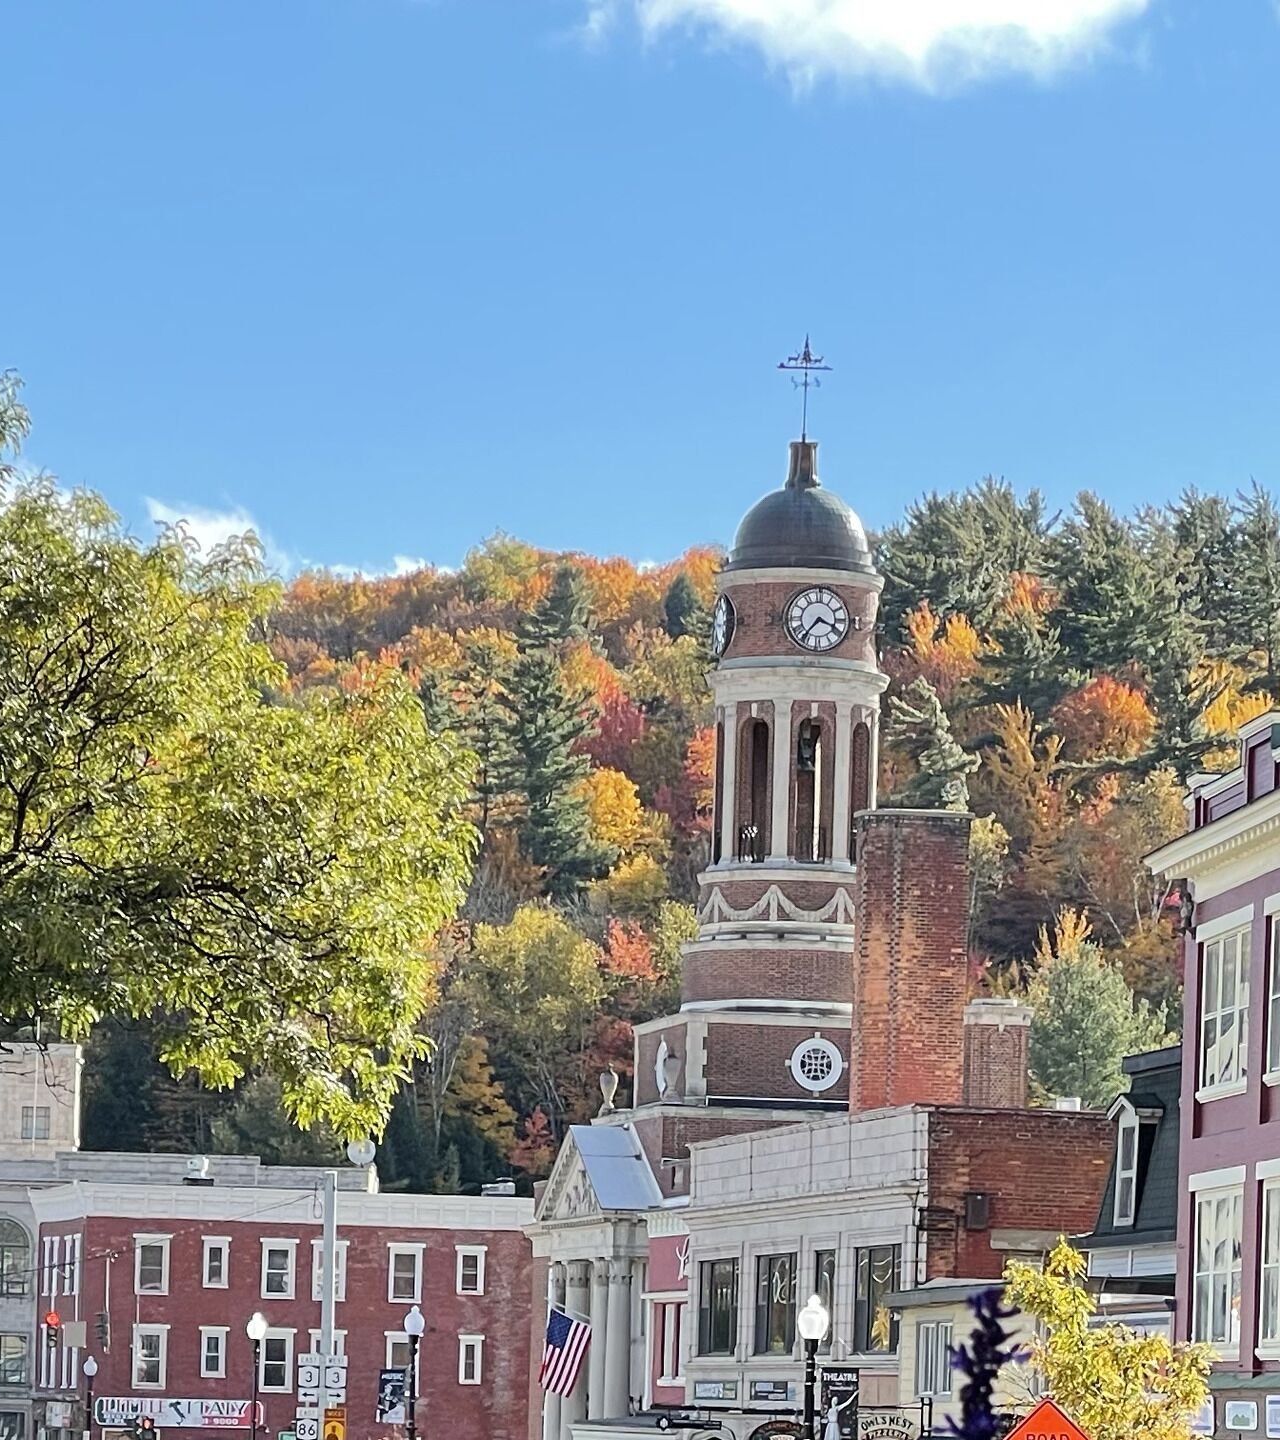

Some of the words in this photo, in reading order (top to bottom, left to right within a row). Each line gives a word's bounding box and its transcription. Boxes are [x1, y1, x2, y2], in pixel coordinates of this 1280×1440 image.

[305, 1370, 313, 1383] 3
[332, 1371, 340, 1384] 3
[823, 1372, 858, 1382] THEATRE
[298, 1423, 316, 1436] 86
